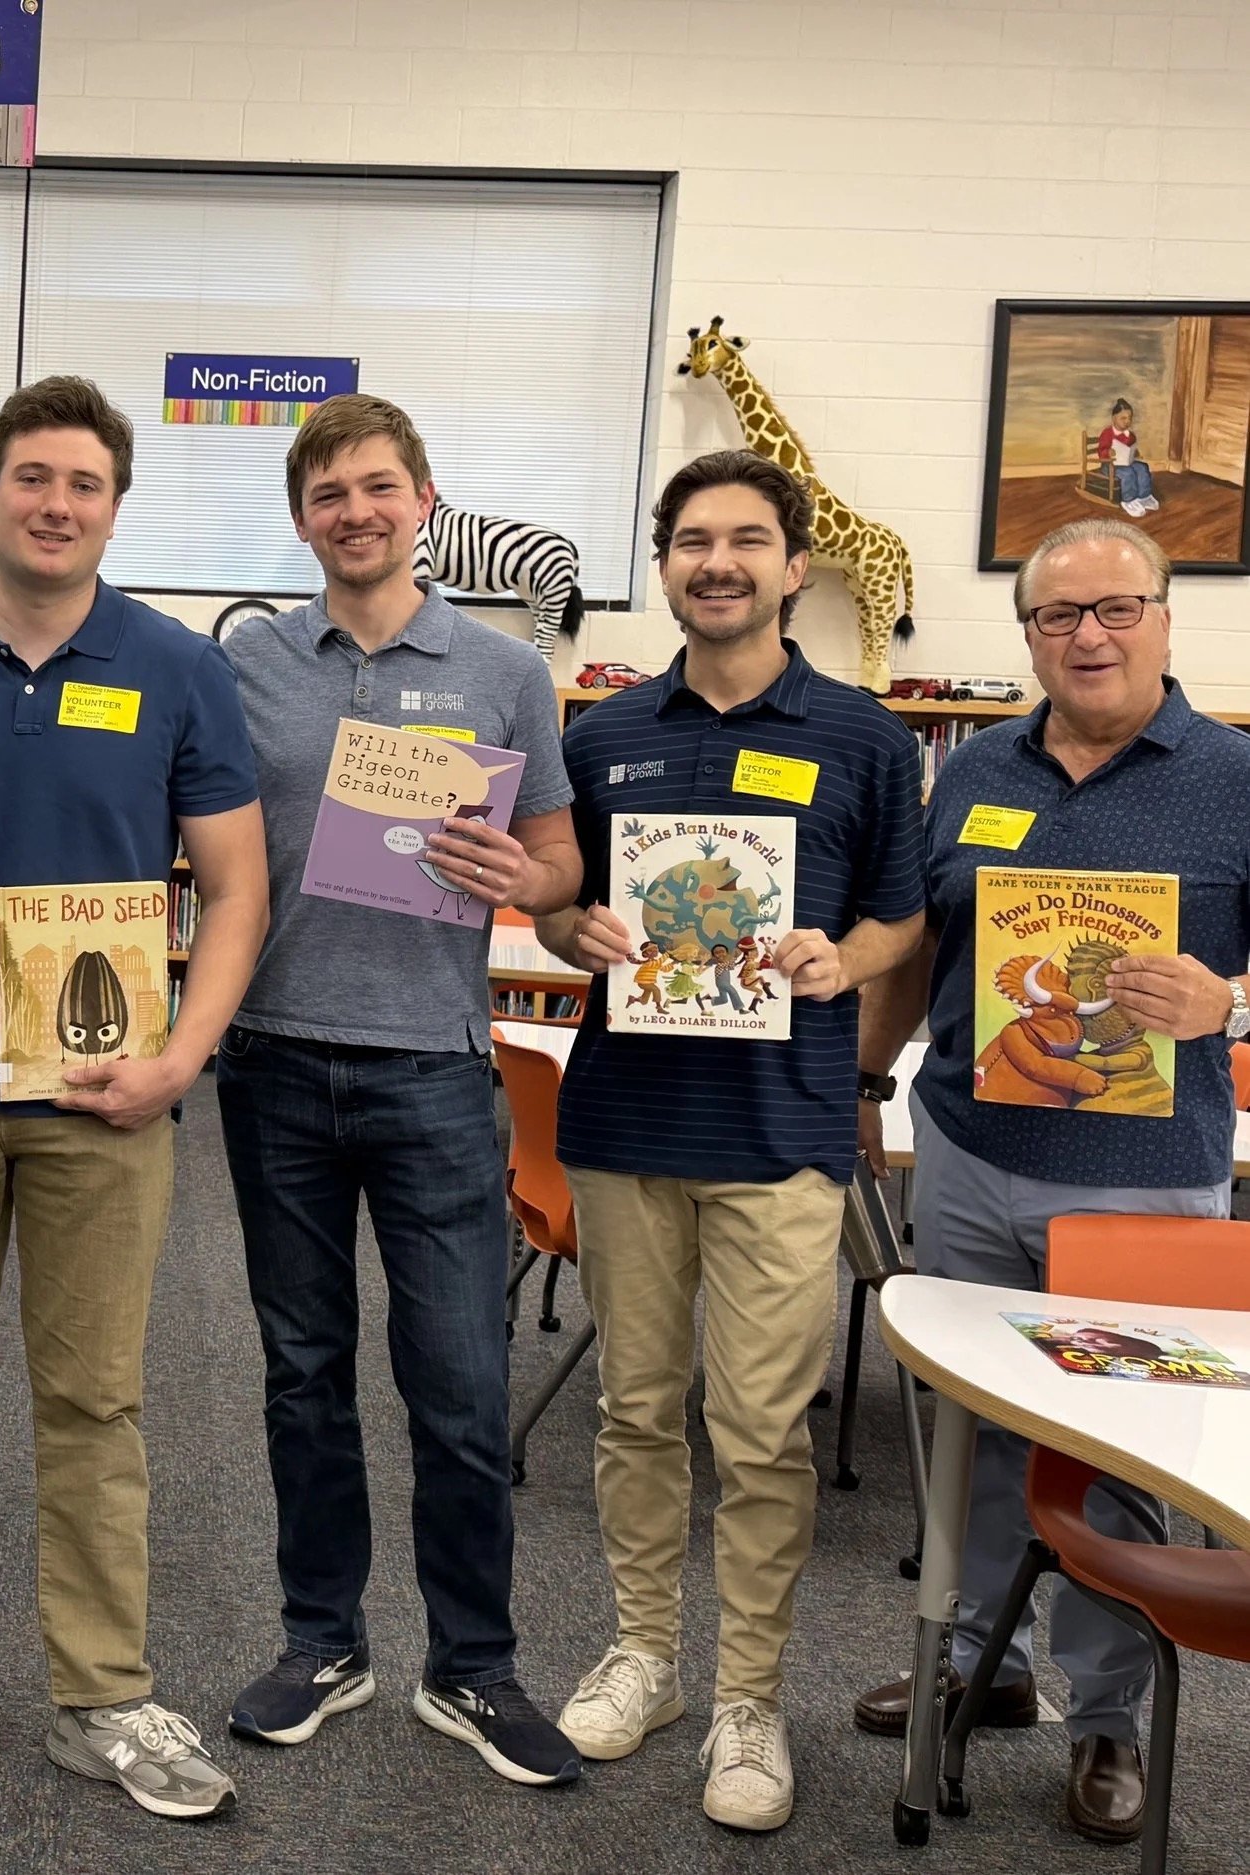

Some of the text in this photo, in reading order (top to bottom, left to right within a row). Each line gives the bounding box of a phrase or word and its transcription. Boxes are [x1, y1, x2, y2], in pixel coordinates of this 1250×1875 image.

[191, 367, 326, 393] Non-Fiction
[65, 696, 121, 710] VOLUNTEER
[422, 691, 464, 702] prudent
[426, 700, 464, 711] growth
[348, 732, 448, 766] Will the
[342, 752, 420, 783] Pigeon
[627, 760, 665, 773] prudent
[629, 768, 664, 781] growth
[741, 764, 782, 777] VISITOR
[337, 773, 457, 809] Graduate?
[970, 817, 1001, 827] VISITOR
[623, 822, 783, 867] If Kids Ran the World
[370, 892, 378, 900] by
[988, 879, 1018, 888] JANE
[1022, 880, 1061, 890] YOLEN
[1076, 882, 1112, 892] MARK
[1117, 884, 1167, 895] TEAGUE
[7, 892, 166, 925] THE BAD SEED
[989, 892, 1162, 940] How Do Dinosaurs
[1012, 910, 1140, 946] Stay Friends?
[629, 1014, 766, 1029] by LEO & DIANE DILLON
[1062, 1351, 1236, 1377] CROWN
[105, 1740, 138, 1770] N
